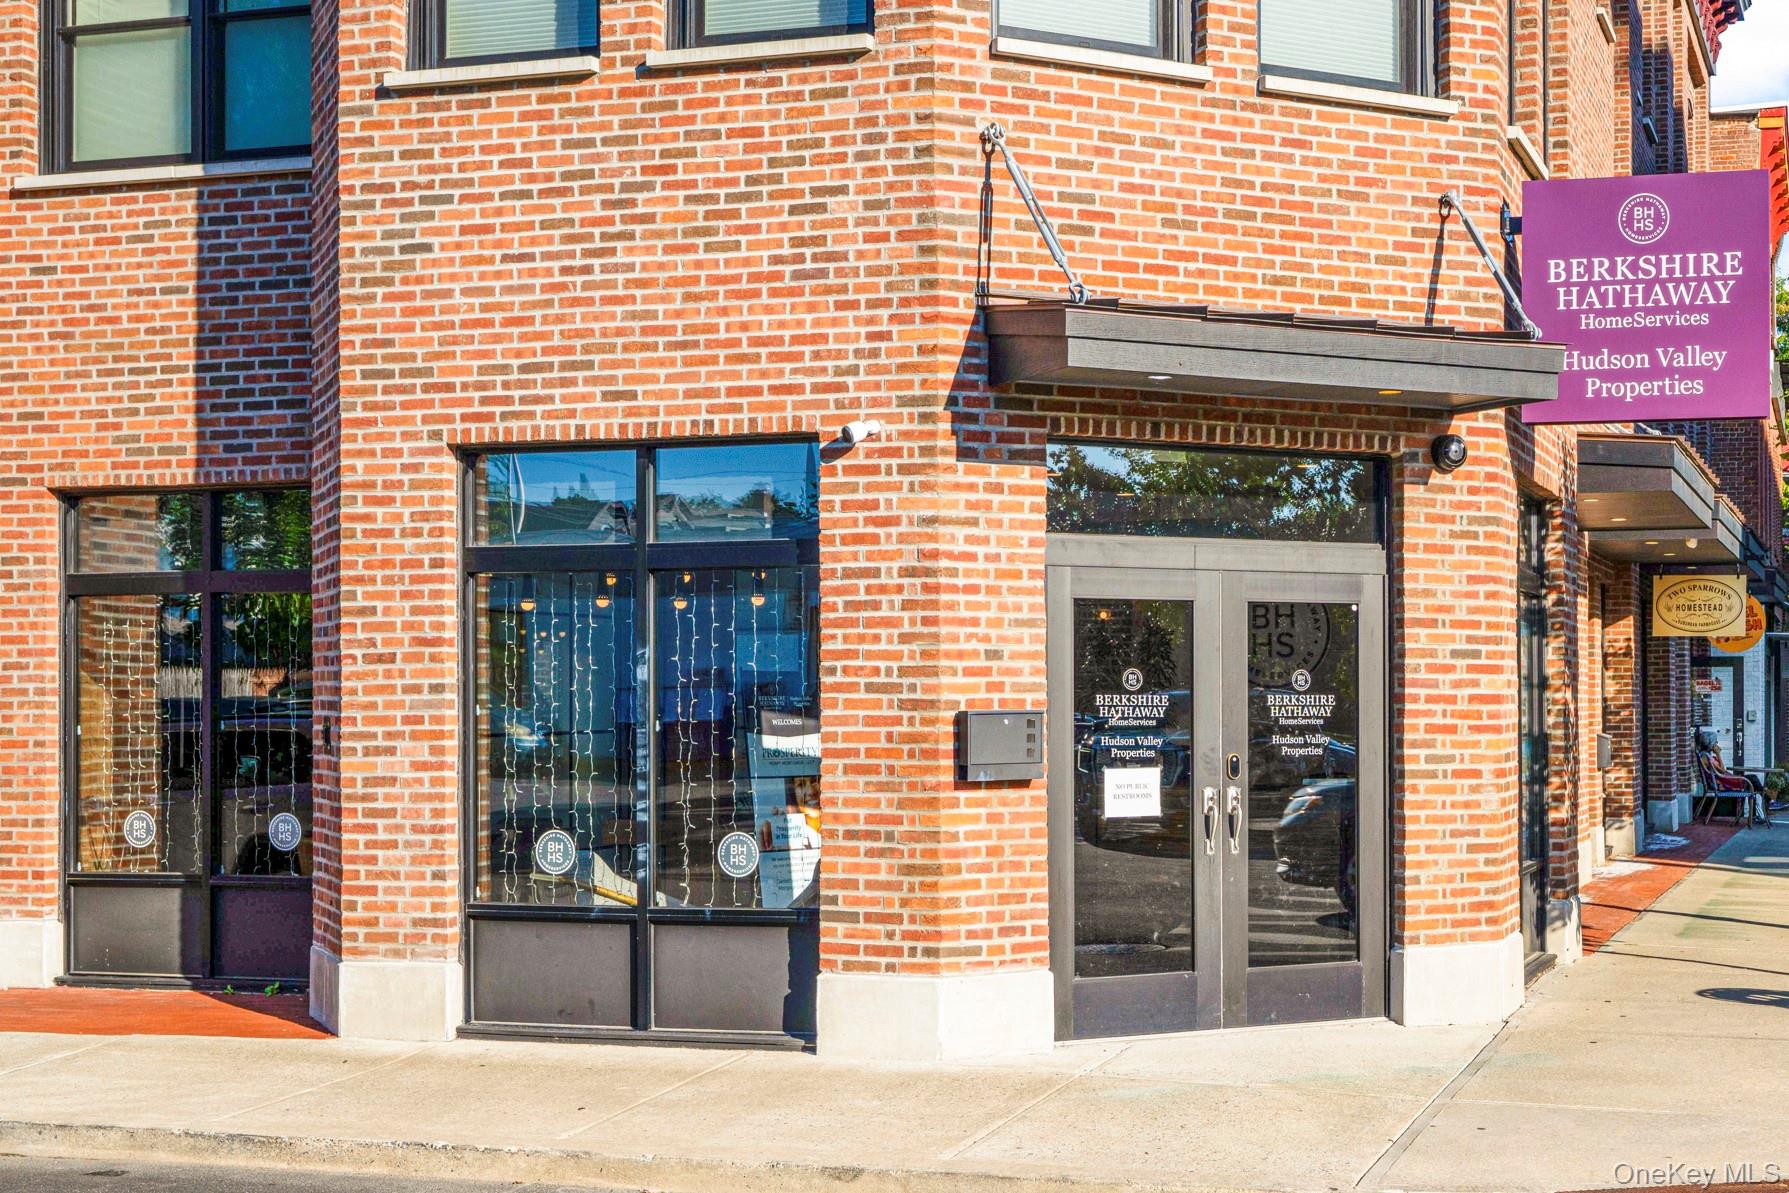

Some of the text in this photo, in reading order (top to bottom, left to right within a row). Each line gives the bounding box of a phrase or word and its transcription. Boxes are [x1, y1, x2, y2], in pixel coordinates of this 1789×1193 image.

[1633, 206, 1654, 218] BH
[1633, 218, 1654, 231] HS
[1547, 251, 1743, 283] BERKSHIRE
[1556, 280, 1736, 310] HATHAWAY
[1580, 311, 1709, 329] HomeServices
[1562, 345, 1727, 371] Hudson Valley
[1585, 375, 1704, 401] Properties
[1666, 584, 1733, 600] TWO SPARROWS
[1675, 603, 1723, 612] HOMESTEAD
[1252, 604, 1295, 629] BH
[1252, 632, 1295, 657] HS
[1095, 695, 1169, 706] BERKSHIRE
[1267, 695, 1336, 706] BERKSHIRE
[1099, 707, 1166, 717] HATHAWAY
[1270, 706, 1333, 717] HATHAWAY
[772, 718, 802, 726] WELCOMES
[1108, 718, 1157, 726] HomeServices
[1279, 717, 1324, 725] HomeServices
[1101, 736, 1163, 748] Hudson Valley
[1272, 734, 1330, 746] Hudson Valley
[762, 746, 817, 758] PROSPERITY
[1111, 748, 1155, 759] Properties
[1281, 746, 1323, 757] Properties
[133, 820, 147, 829] BH
[278, 822, 292, 832] BH
[133, 829, 146, 838] HS
[278, 832, 292, 841] HS
[547, 841, 564, 852] BH
[730, 844, 747, 855] BH
[547, 852, 563, 863] HS
[730, 855, 747, 866] HS
